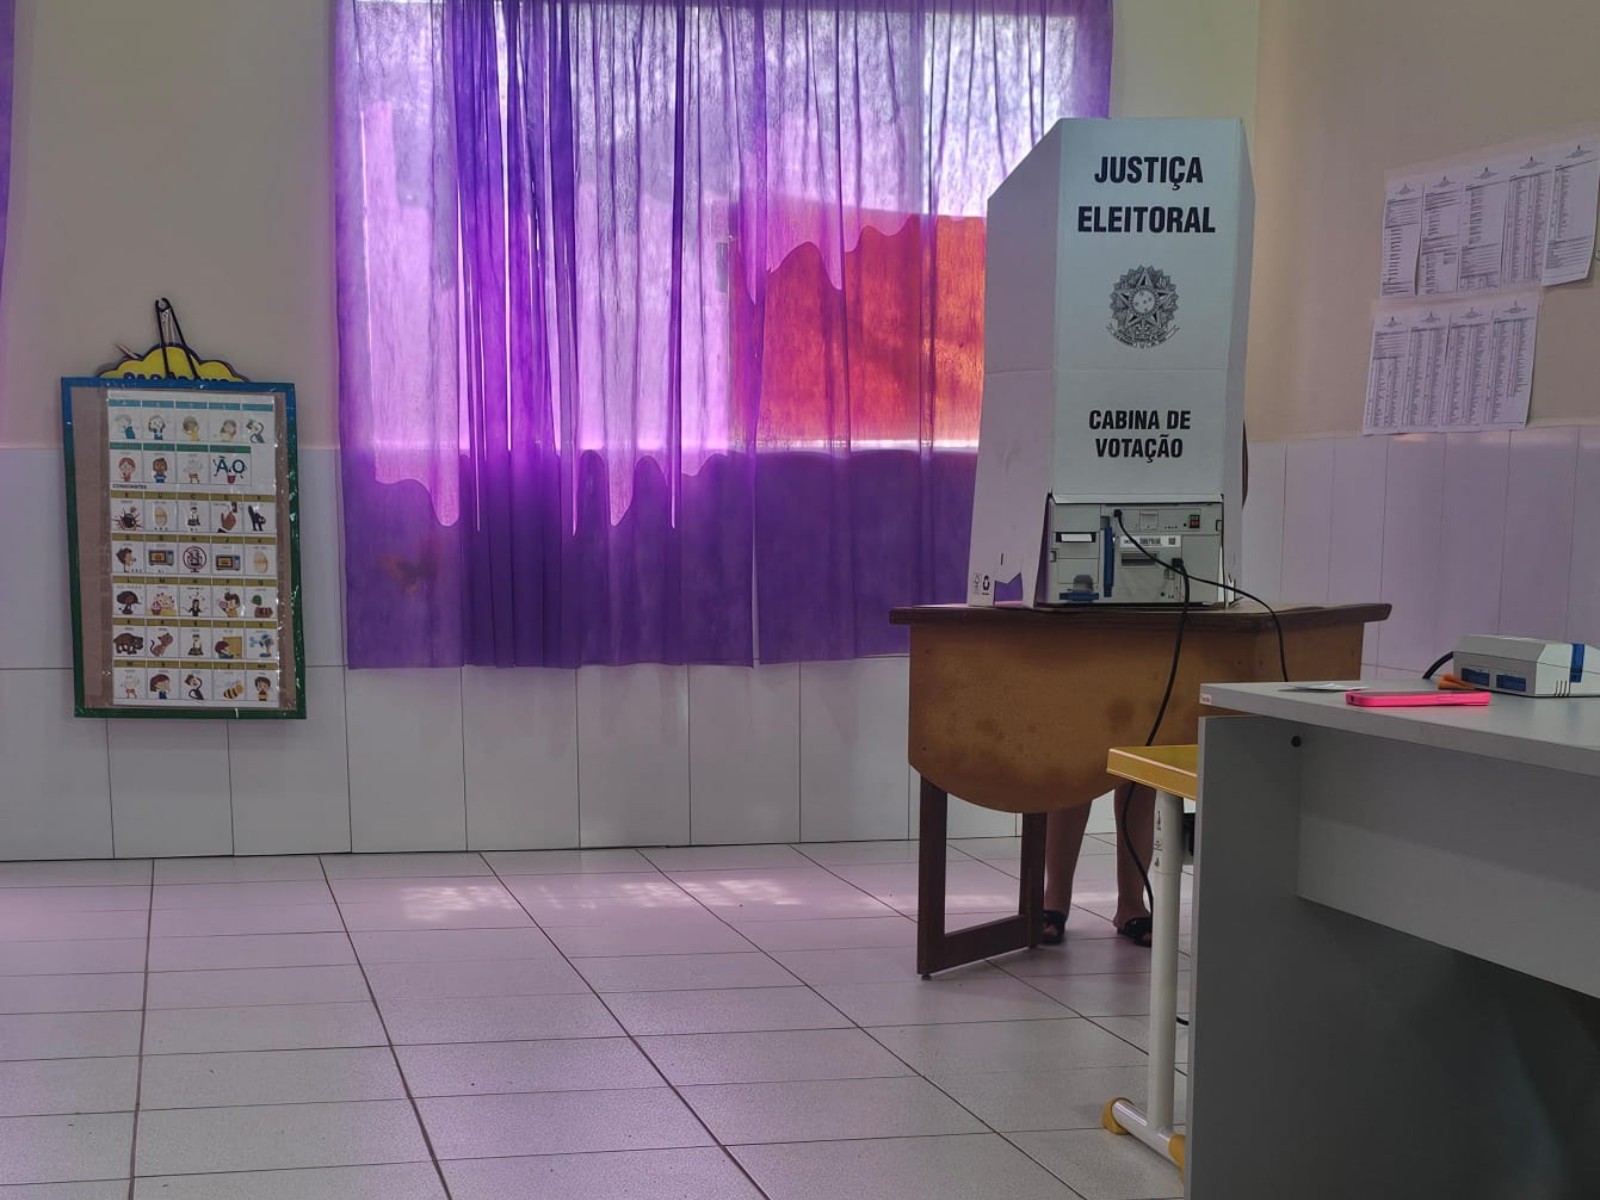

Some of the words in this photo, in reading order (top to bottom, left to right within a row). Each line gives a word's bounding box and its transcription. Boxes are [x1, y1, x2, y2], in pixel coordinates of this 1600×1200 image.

[1094, 156, 1204, 191] JUSTIÇA
[1077, 205, 1216, 234] ELEITORAL
[1088, 409, 1160, 430] CABINA
[1166, 409, 1192, 430] DE
[1095, 433, 1184, 463] VOTAÇÃO
[216, 455, 246, 474] ÃO
